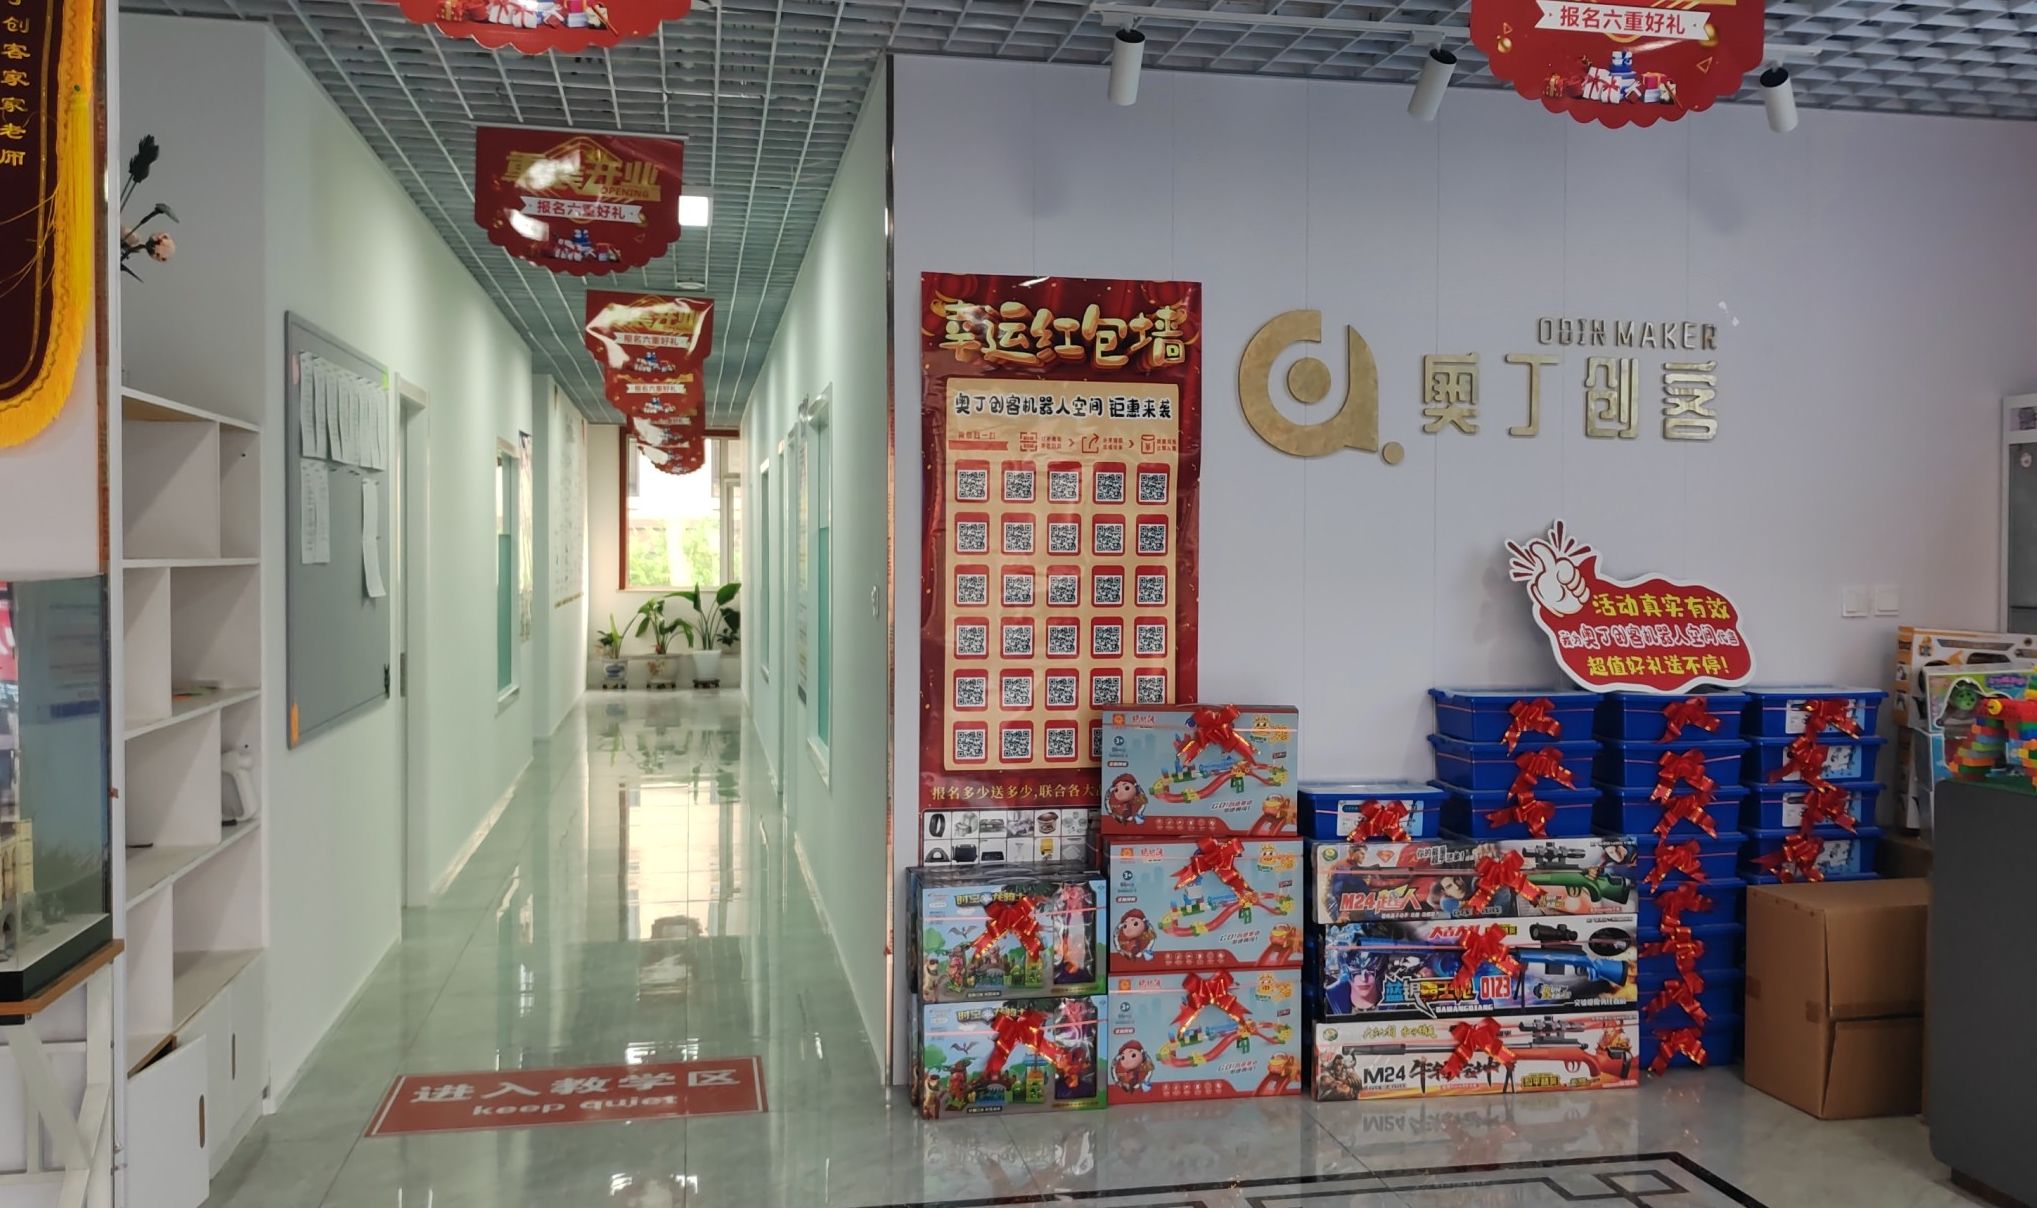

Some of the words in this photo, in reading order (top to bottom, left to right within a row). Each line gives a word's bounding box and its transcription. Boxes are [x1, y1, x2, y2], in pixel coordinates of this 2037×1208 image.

[1560, 7, 1686, 35] 报名六重好礼
[601, 186, 650, 198] OPENING
[537, 200, 626, 219] 报名六重好礼
[938, 299, 1187, 367] 幸运红包墙
[1539, 317, 1607, 346] ODIN
[1614, 320, 1718, 349] MAKER
[955, 393, 1103, 417] 奥丁创客机器人空间
[1421, 352, 1719, 440] 奥丁创客
[1592, 593, 1730, 620] 活动真实有效
[1558, 623, 1740, 649] 我为奥丁创客机器人空间代言
[1587, 655, 1730, 677] 超值好礼送不停!
[931, 783, 1101, 800] 报名多少送多少,联合各大
[410, 1069, 741, 1103] 进入教学区
[1363, 1065, 1406, 1084] M24
[473, 1103, 566, 1116] keep
[580, 1096, 678, 1111] quiet
